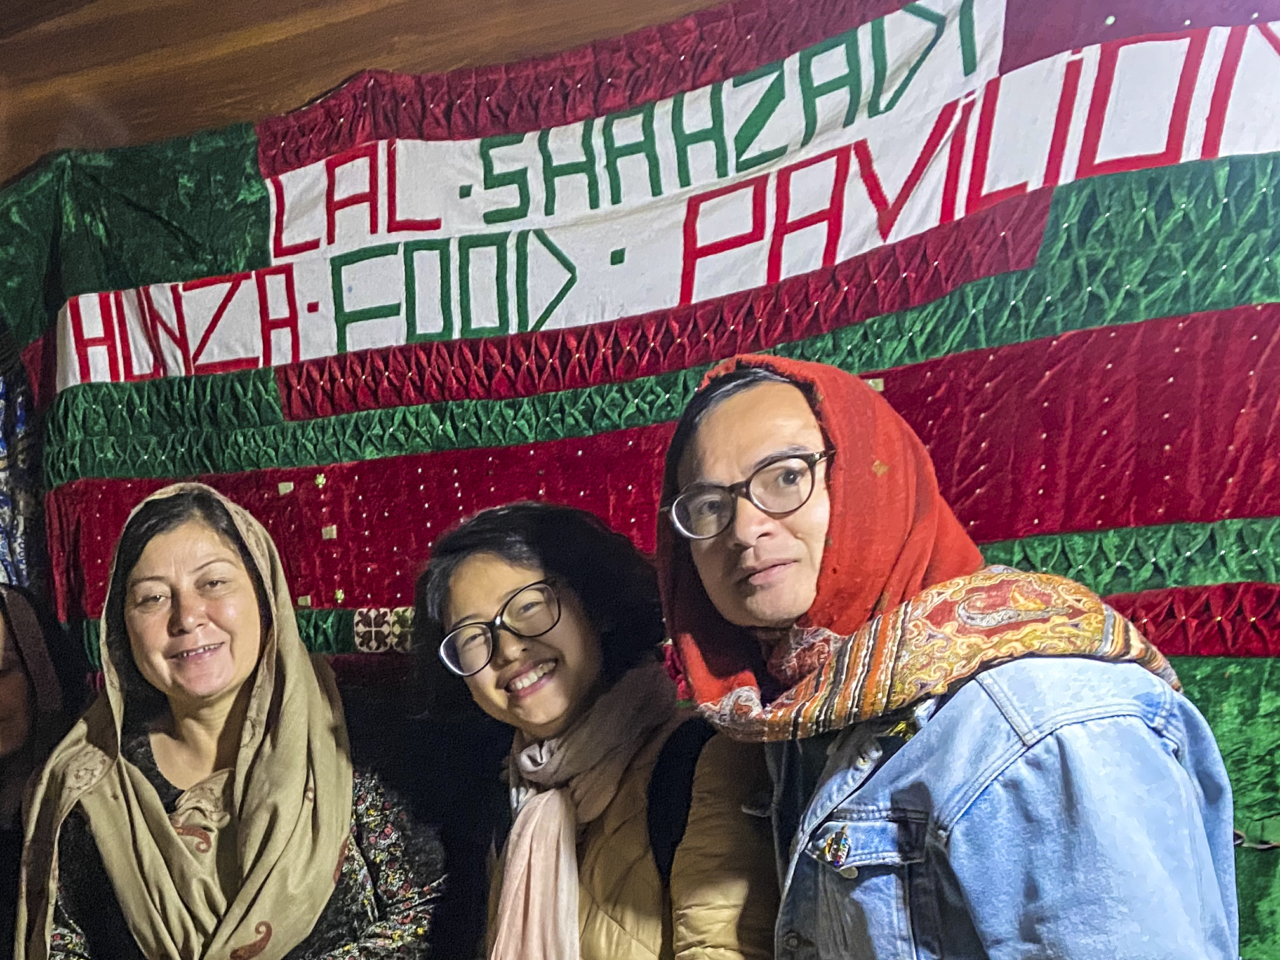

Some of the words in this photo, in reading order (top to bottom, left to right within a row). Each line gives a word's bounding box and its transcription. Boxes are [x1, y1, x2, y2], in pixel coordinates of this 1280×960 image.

[271, 138, 441, 258] LAL
[480, 0, 977, 225] SHAHZADI
[67, 262, 300, 383] HUNZA
[332, 227, 577, 355] FOOD
